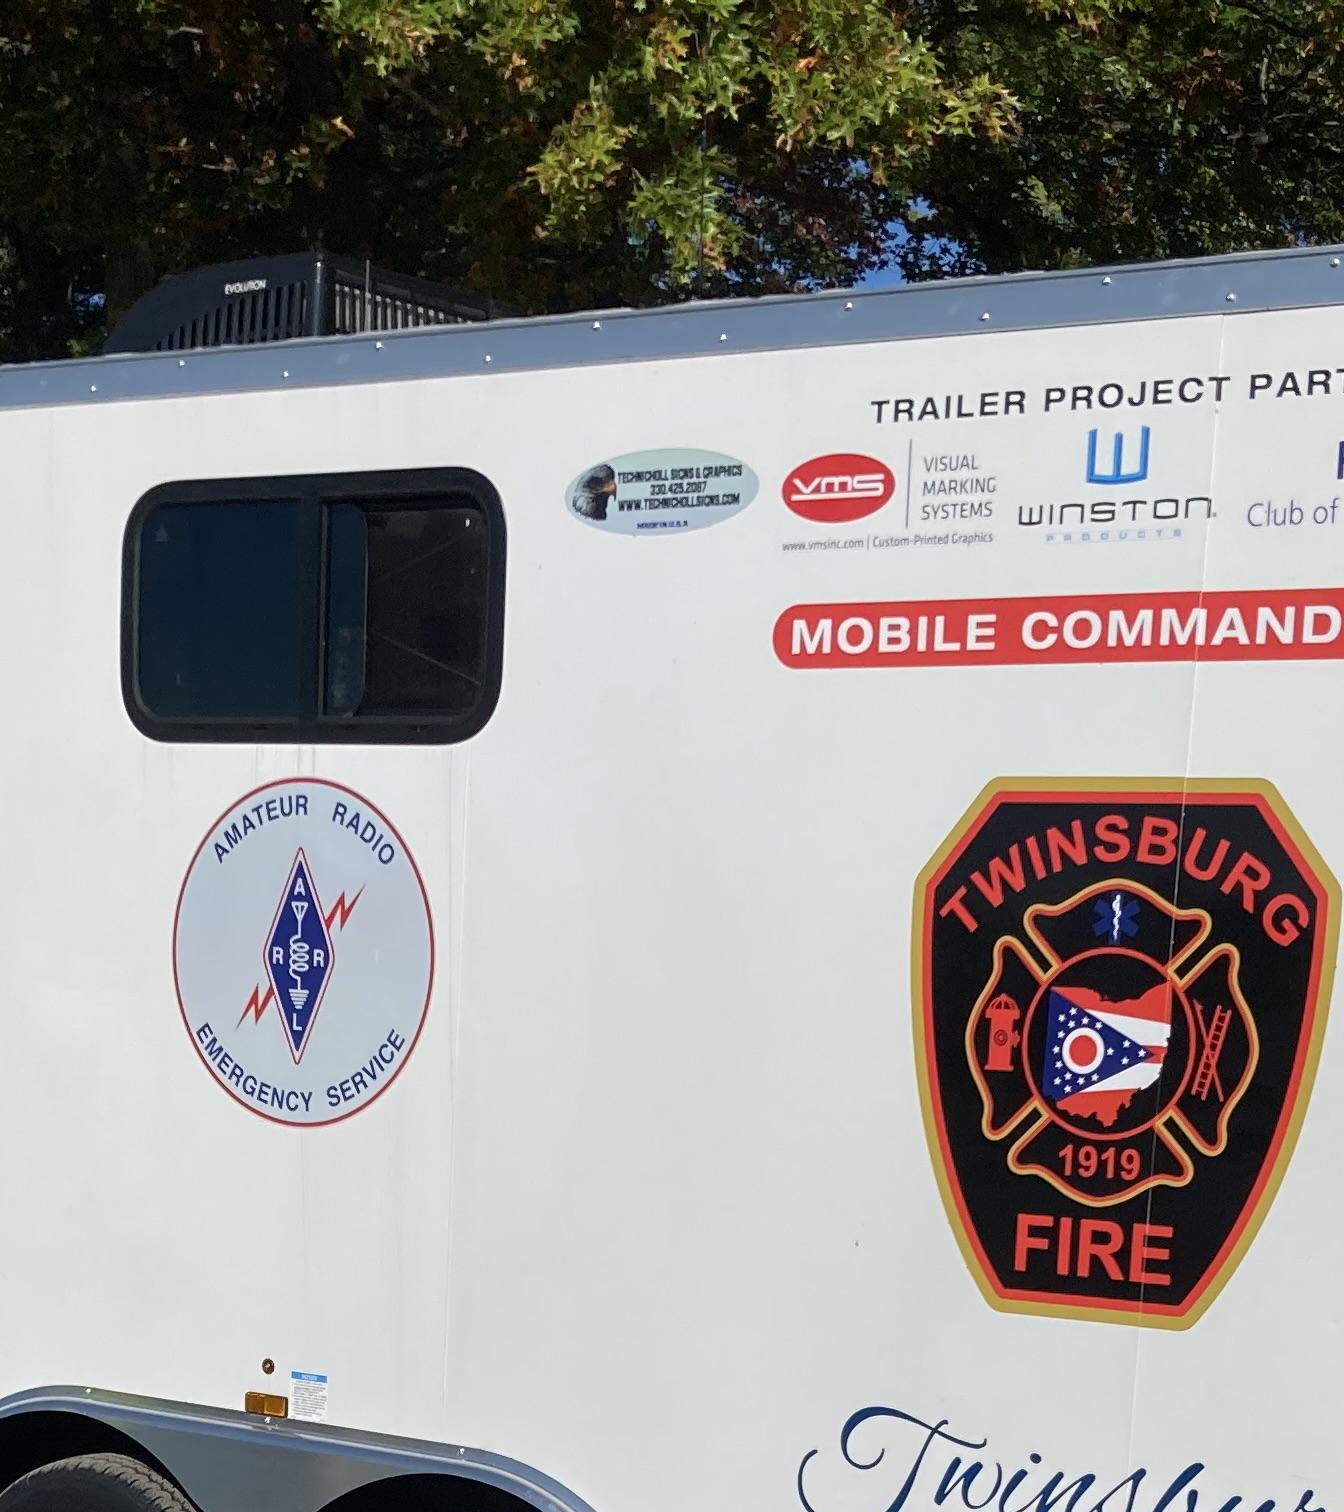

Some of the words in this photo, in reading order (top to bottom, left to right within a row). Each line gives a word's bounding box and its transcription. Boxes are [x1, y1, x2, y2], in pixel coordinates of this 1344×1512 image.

[870, 389, 1027, 425] TRAILER
[1043, 376, 1231, 413] PROJECT
[923, 454, 979, 473] VISUAL
[921, 476, 997, 496] MARKING
[921, 501, 994, 520] SYSTEMS
[1246, 499, 1305, 528] Club
[1312, 498, 1340, 525] of
[782, 536, 864, 551] www.vmsinc.com
[872, 533, 950, 549] Custom-Printed
[951, 531, 994, 547] Graphics
[1046, 528, 1182, 543] PRODUCTS
[790, 612, 998, 656] MOBILE
[1021, 603, 1343, 651] COMMAND
[212, 794, 309, 864] AMATEUR
[331, 801, 396, 866] RADIO
[938, 814, 1310, 948] TWINSBURG
[195, 1022, 313, 1113] EMERGENCY
[326, 1028, 406, 1108] SERVICE
[1057, 1143, 1142, 1182] 1919
[1013, 1212, 1174, 1287] FIRE
